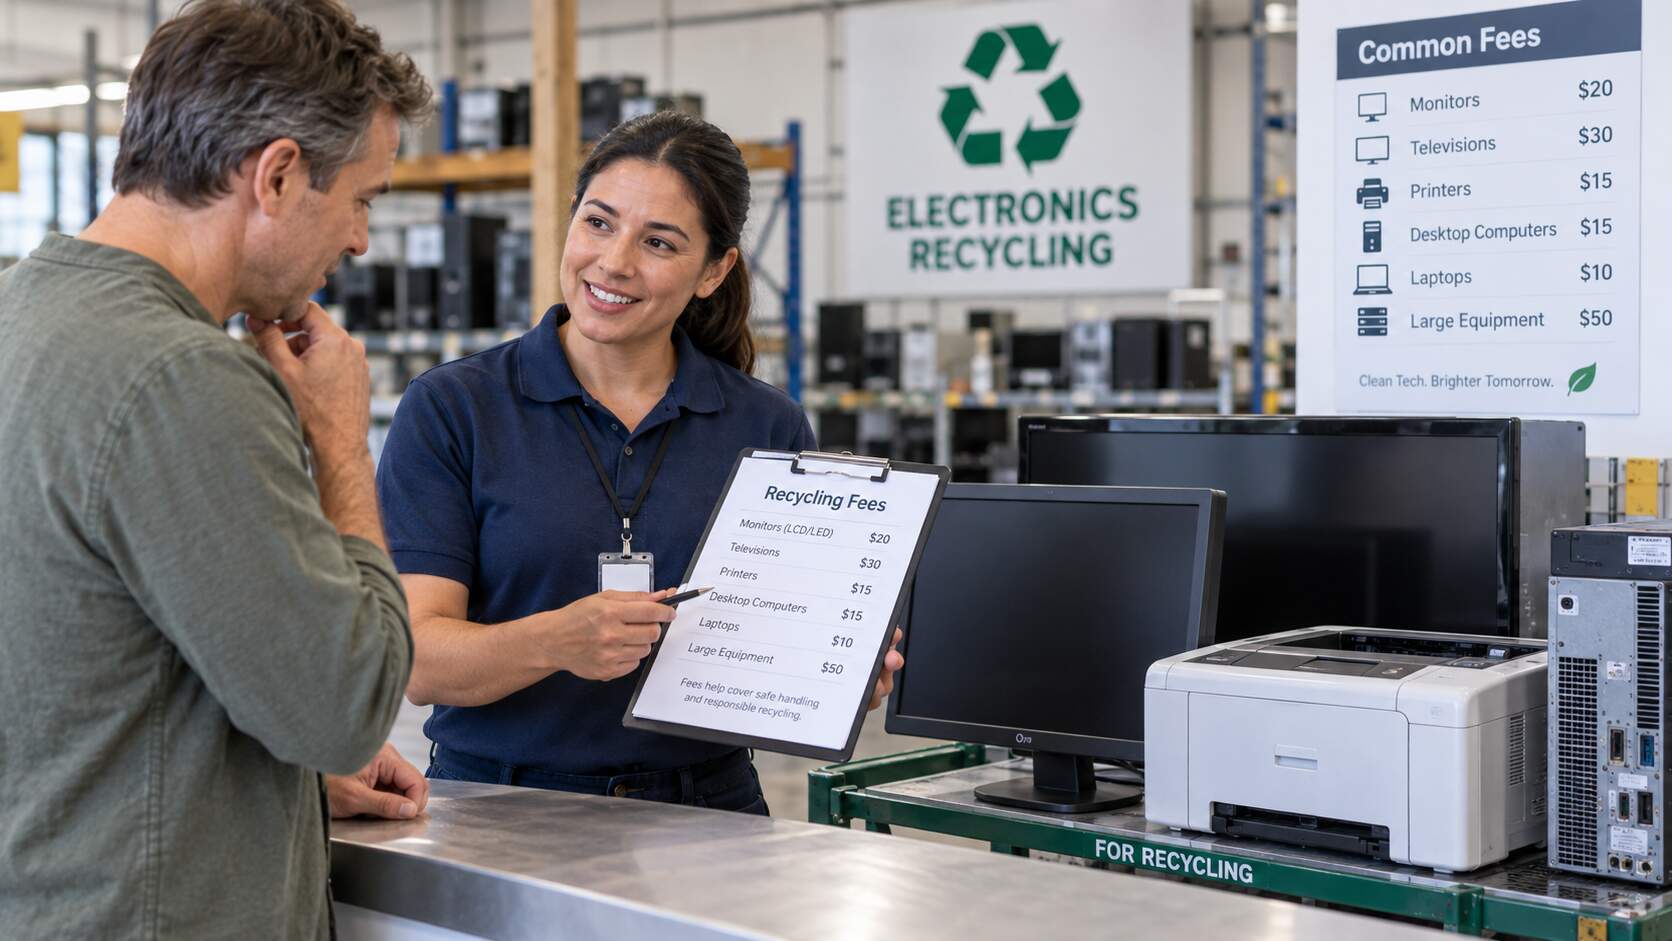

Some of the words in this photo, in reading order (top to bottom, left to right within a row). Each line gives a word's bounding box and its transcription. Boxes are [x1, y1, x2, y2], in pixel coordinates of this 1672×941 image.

[1359, 35, 1471, 64] Common
[1481, 26, 1541, 52] Fees
[1411, 94, 1480, 112] Monitors
[1579, 80, 1612, 100] $20
[1410, 137, 1496, 155] Televisions
[1579, 126, 1612, 146] $30
[1411, 183, 1471, 198] Printers
[1580, 171, 1612, 191] $15
[887, 185, 1139, 230] ELECTRONICS
[1411, 226, 1470, 243] Desktop
[1475, 224, 1557, 242] Computers
[1581, 217, 1612, 237] $15
[910, 232, 1113, 271] RECYCLING
[1411, 271, 1472, 288] Laptops
[1581, 263, 1612, 282] $10
[1411, 314, 1454, 332] Large
[1460, 312, 1544, 331] Equipment
[1580, 309, 1612, 328] $50
[1359, 374, 1393, 387] Clean
[1396, 374, 1427, 387] Tech.
[1431, 375, 1481, 390] Brighter
[1485, 375, 1554, 387] Tomorrow.
[765, 486, 844, 510] Recycling
[847, 494, 886, 511] Fees
[740, 519, 782, 532] Monitors
[784, 523, 833, 538] (LCD/LED)
[869, 532, 890, 544] $20
[731, 542, 780, 557] Televisions
[860, 558, 881, 569] $30
[720, 567, 758, 580] Printers
[851, 582, 872, 595] $15
[709, 592, 750, 607] Desktop
[752, 597, 807, 613] Computers
[841, 608, 863, 621] $15
[699, 617, 740, 632] Laptops
[832, 635, 853, 648] $10
[688, 642, 717, 656] Large
[718, 647, 774, 664] Equipment
[821, 662, 843, 674] $50
[680, 678, 703, 689] Fees
[704, 681, 725, 694] help
[727, 686, 754, 697] cover
[755, 691, 776, 701] safe
[778, 693, 820, 710] handling
[684, 695, 704, 704] and
[704, 698, 756, 712] responsible
[758, 706, 801, 721] recycling.
[1096, 839, 1134, 863] FOR
[1142, 848, 1253, 884] RECYCLING
